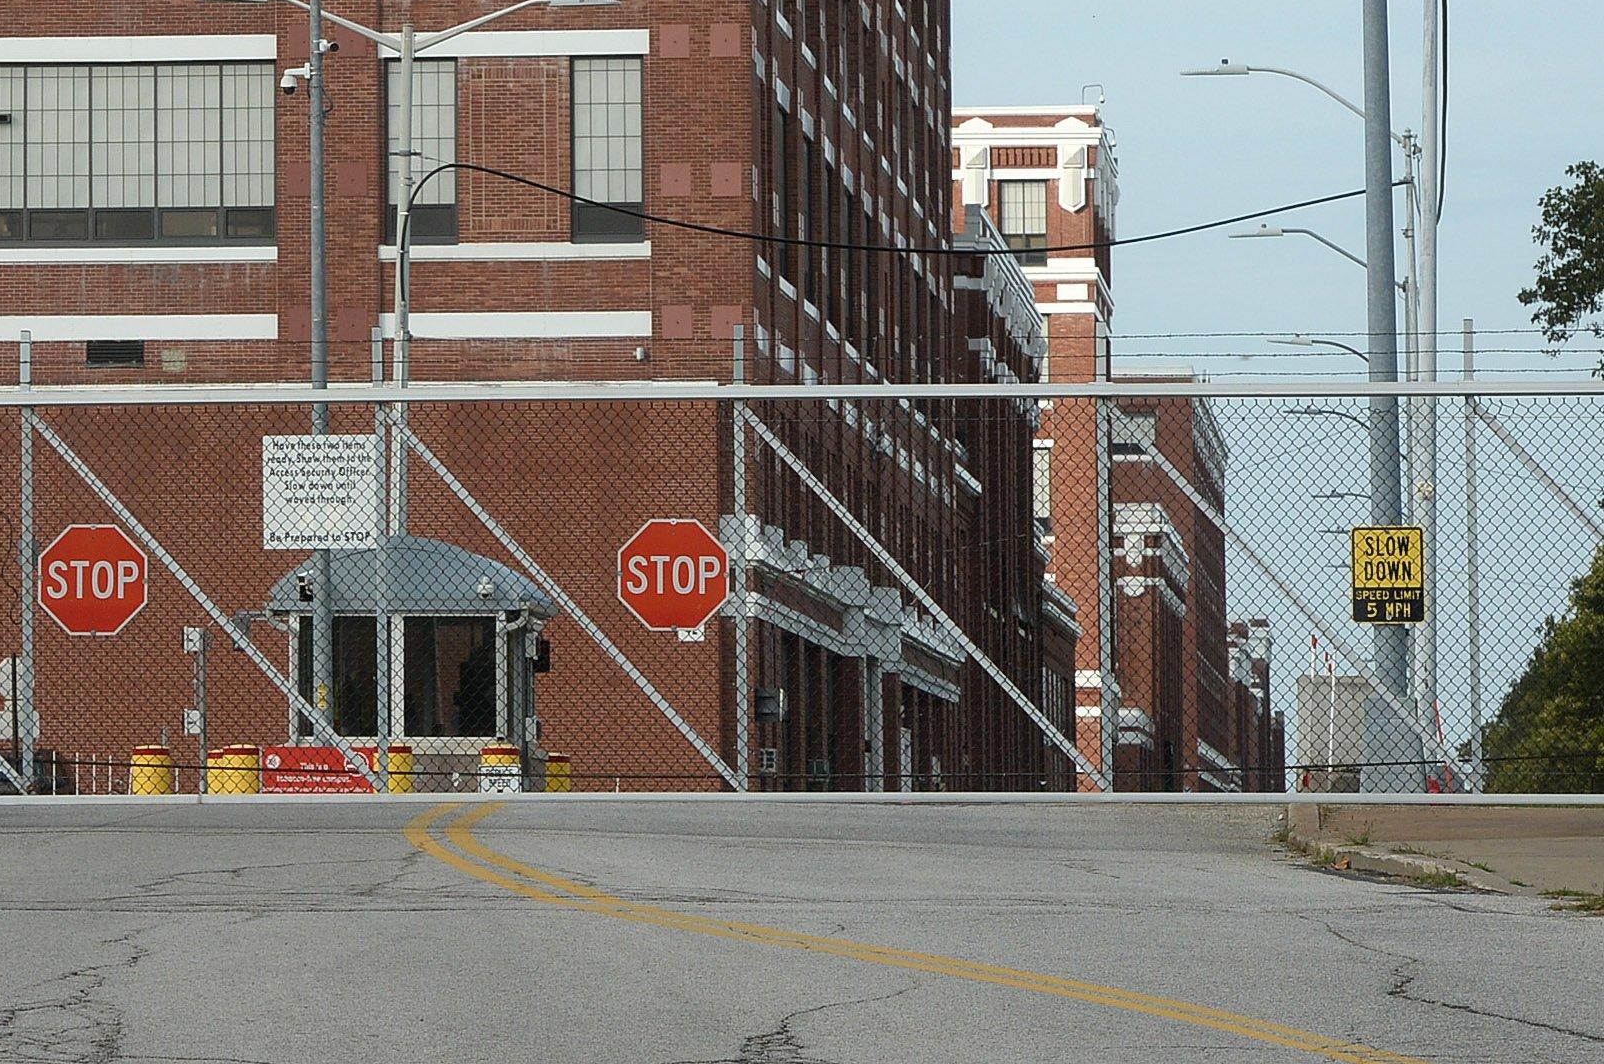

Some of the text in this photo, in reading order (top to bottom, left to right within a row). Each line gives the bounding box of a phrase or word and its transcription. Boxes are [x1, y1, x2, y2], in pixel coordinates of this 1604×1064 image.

[284, 531, 329, 544] Prepared
[344, 531, 371, 542] STOP
[1364, 536, 1410, 556] SLOW
[46, 560, 139, 599] STOP
[626, 555, 721, 595] STOP
[1364, 561, 1412, 581] DOWN
[1356, 590, 1421, 600] SPEED LIMIT
[1366, 602, 1411, 618] 5 MPH
